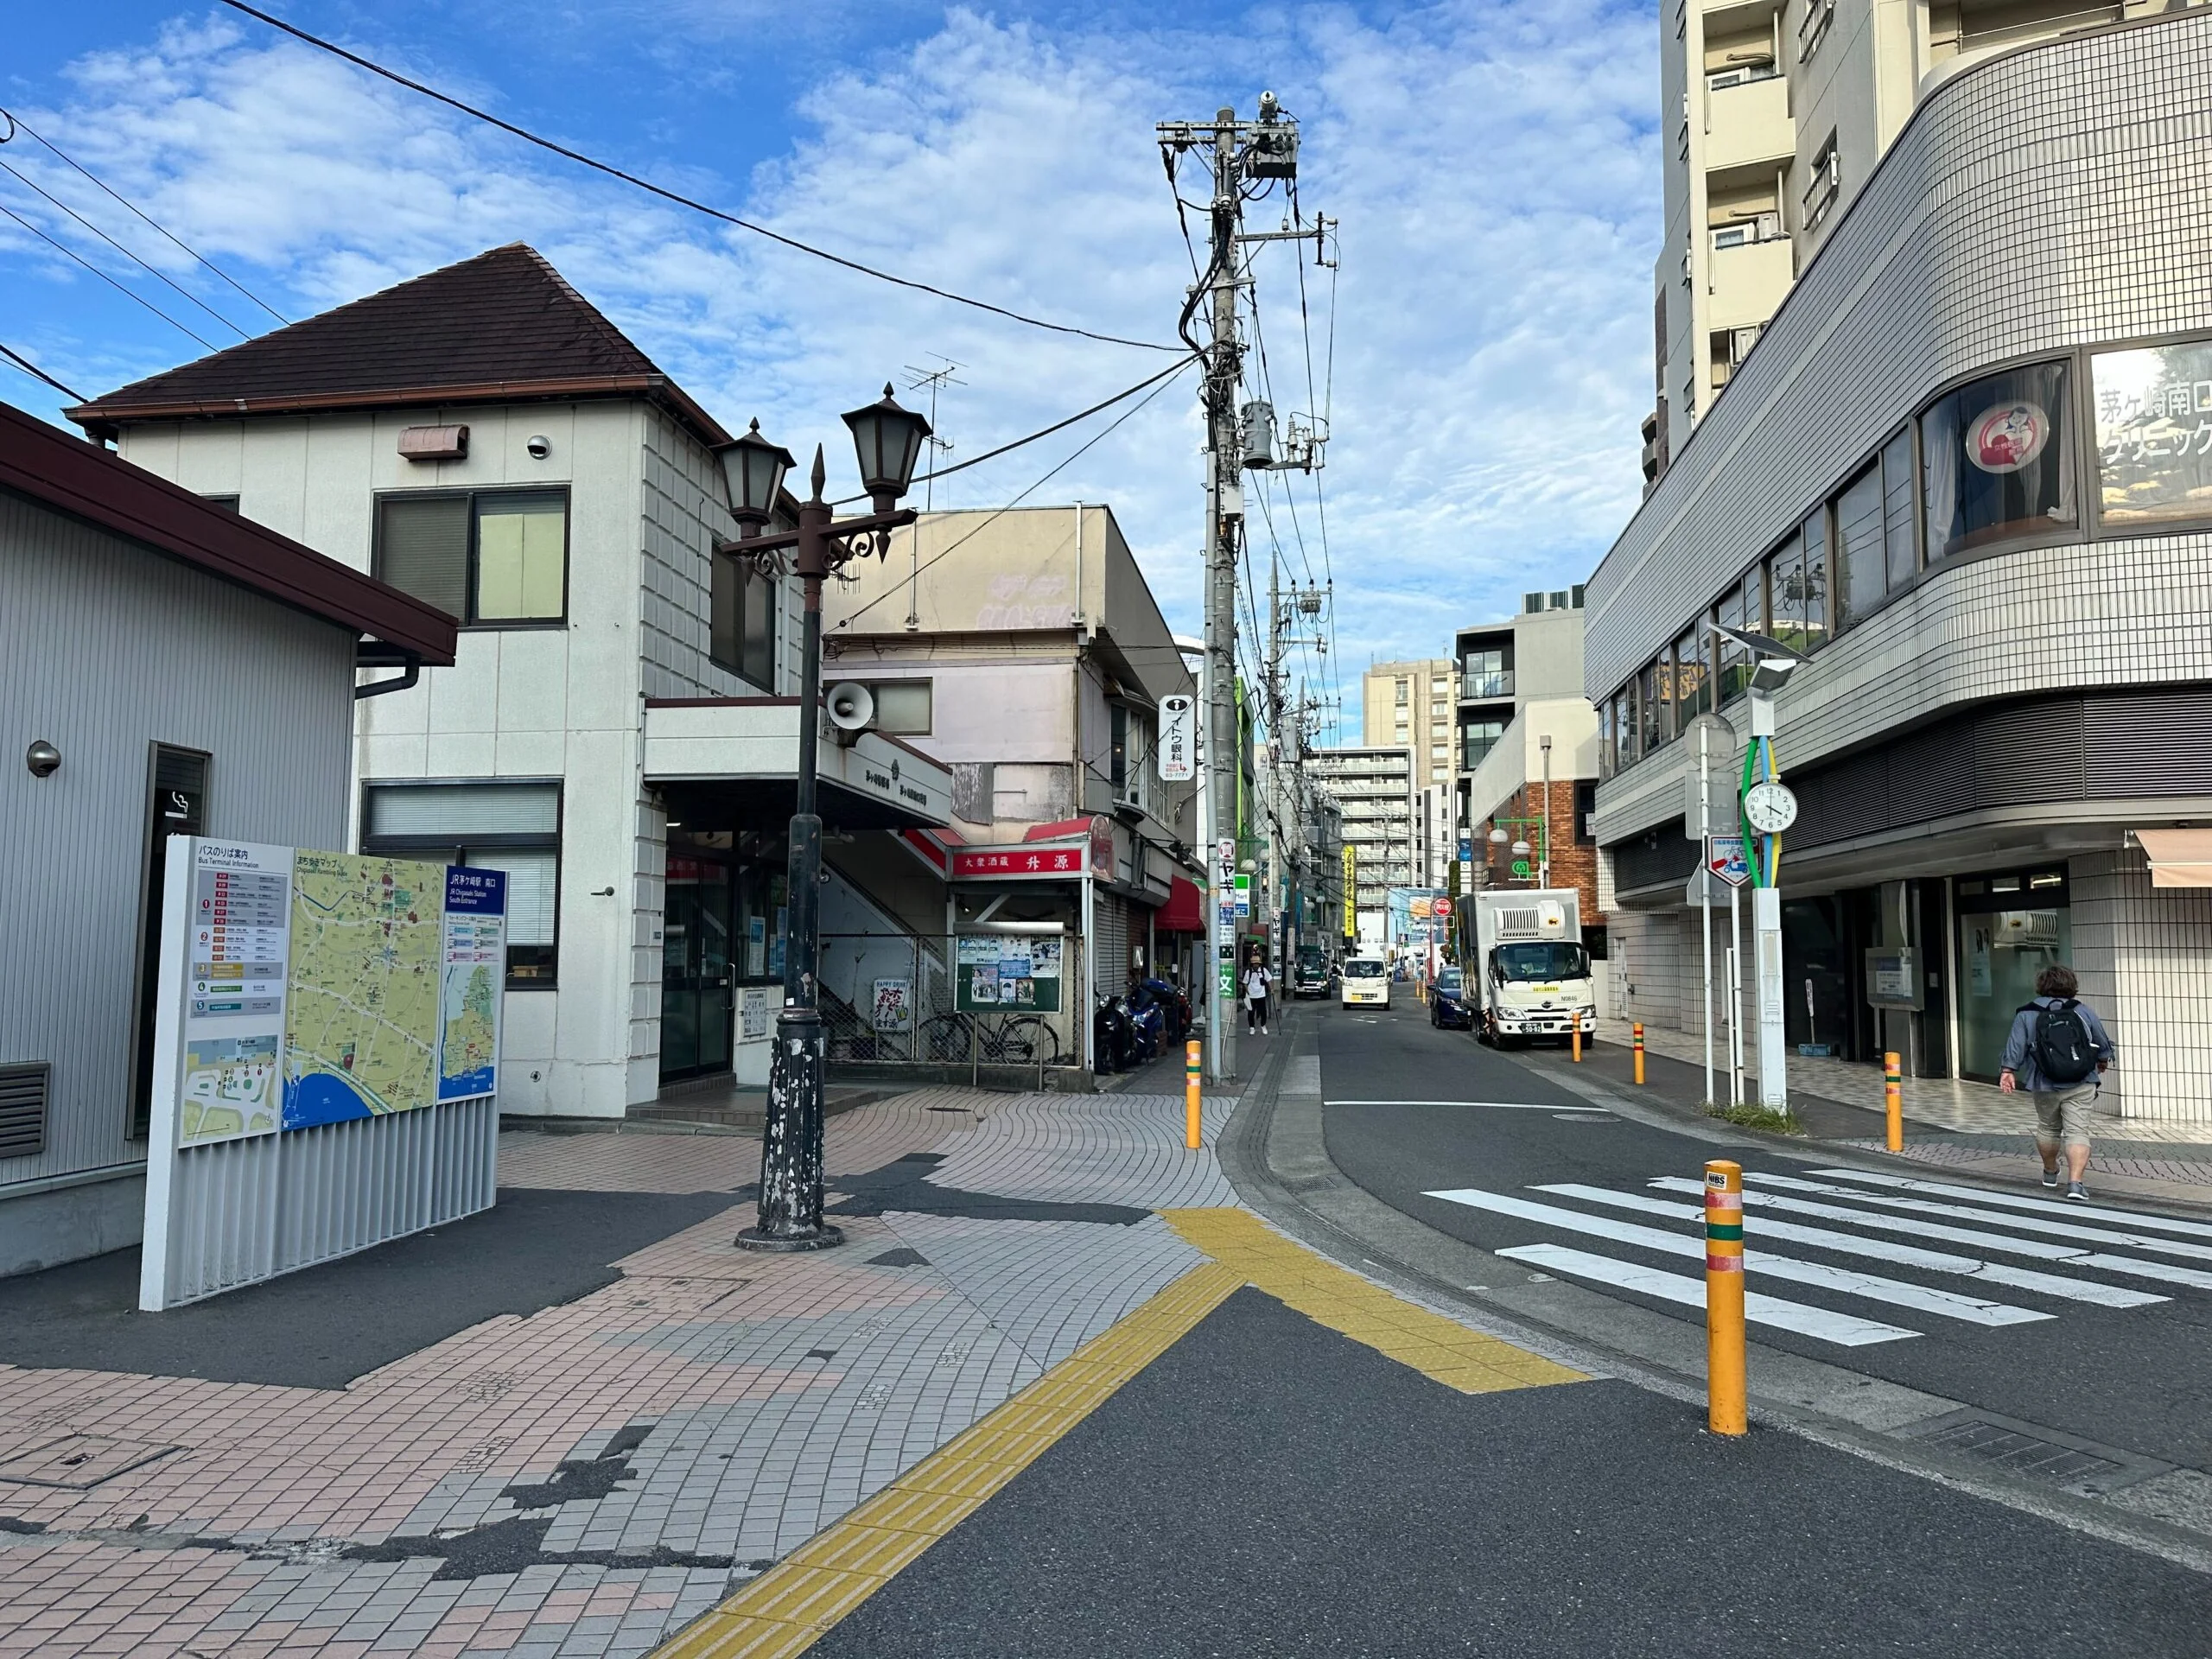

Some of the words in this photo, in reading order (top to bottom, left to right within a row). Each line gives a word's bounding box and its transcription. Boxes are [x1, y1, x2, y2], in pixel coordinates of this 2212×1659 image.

[2103, 419, 2212, 464] クリニック
[1171, 716, 1182, 762] イトウ眼科
[199, 845, 248, 860] バスのりば案内
[209, 857, 232, 866] Terminal
[232, 860, 259, 869] Information
[296, 855, 337, 868] まち歩きマップ
[964, 855, 1009, 868] 大衆酒蔵
[1026, 854, 1069, 871] 升源
[485, 878, 496, 888] 南口
[1219, 862, 1234, 894] ヤギ
[461, 896, 478, 905] Entrance
